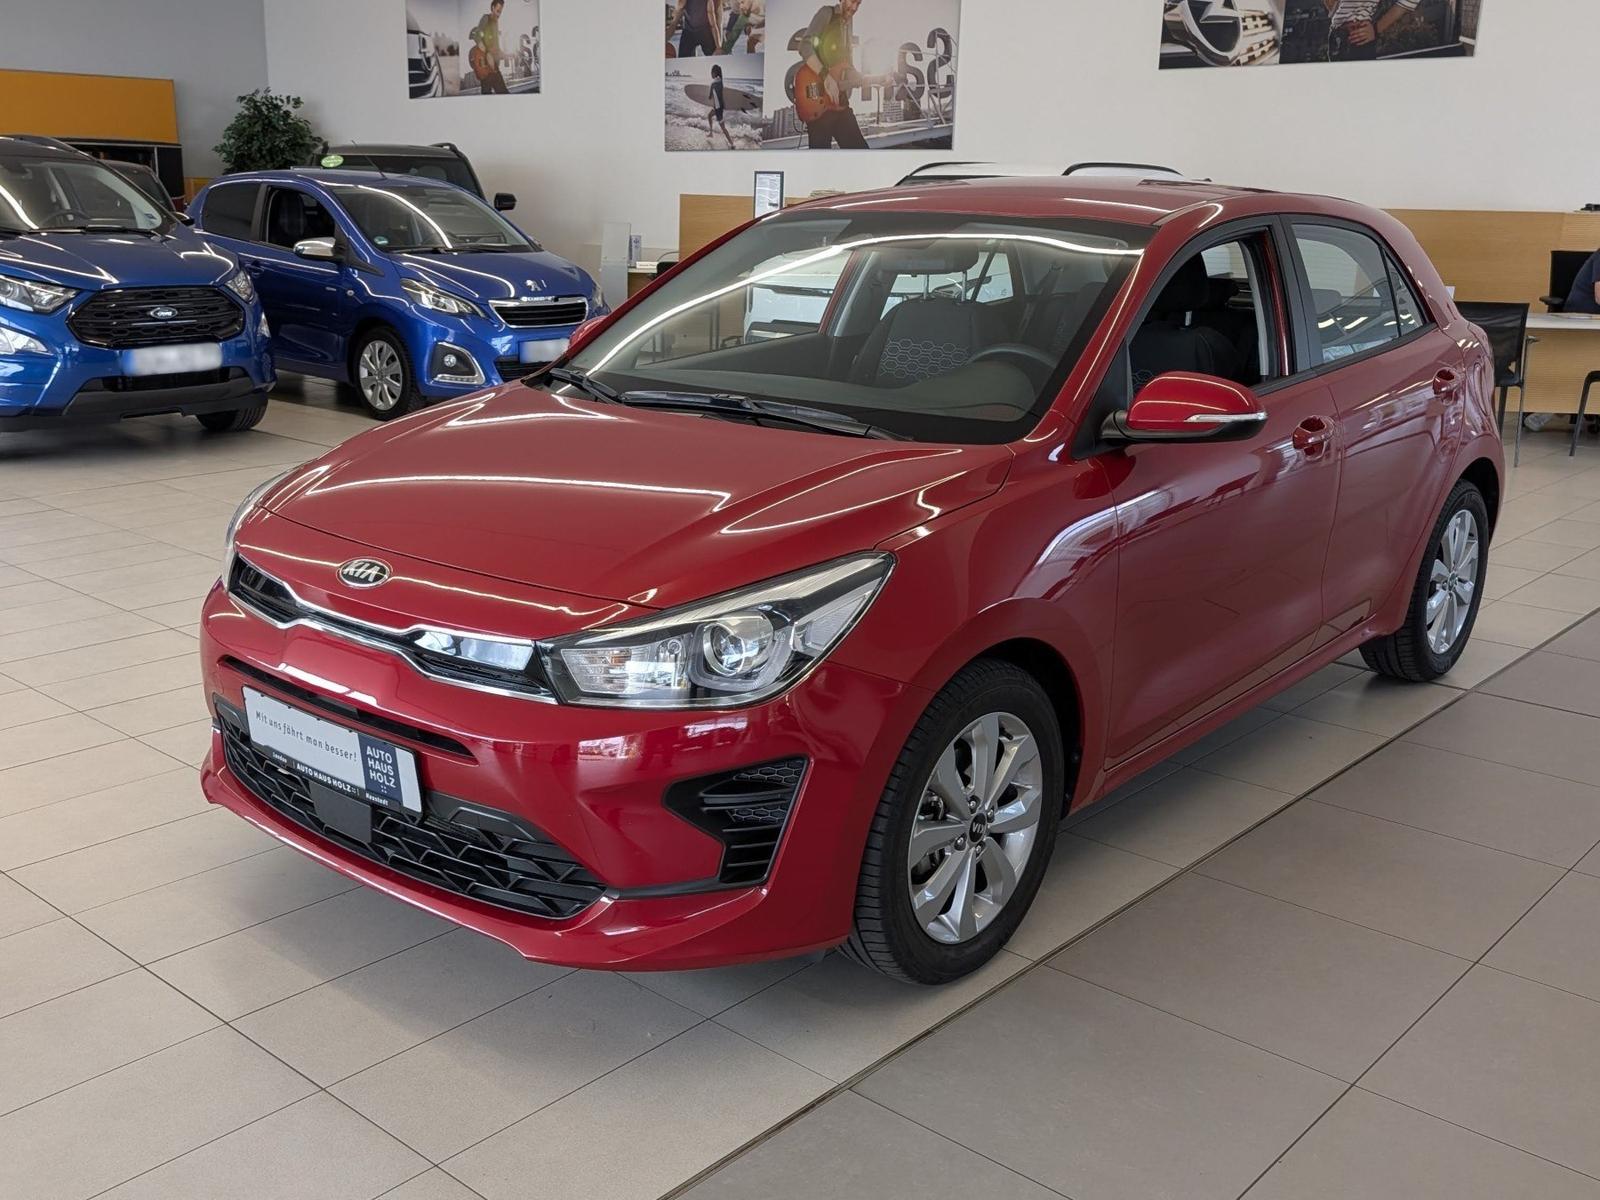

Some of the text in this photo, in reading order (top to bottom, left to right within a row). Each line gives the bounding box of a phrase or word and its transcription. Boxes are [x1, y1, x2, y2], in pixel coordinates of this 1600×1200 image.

[343, 560, 380, 582] KIA
[255, 710, 267, 724] Mit
[269, 719, 282, 731] uns
[324, 741, 357, 762] besser!
[366, 745, 393, 764] AUTO
[367, 757, 394, 775] HAUS
[296, 762, 313, 776] AUTO
[313, 770, 331, 784] HAUS
[332, 778, 351, 793] HOLZ
[369, 769, 396, 788] HOLZ
